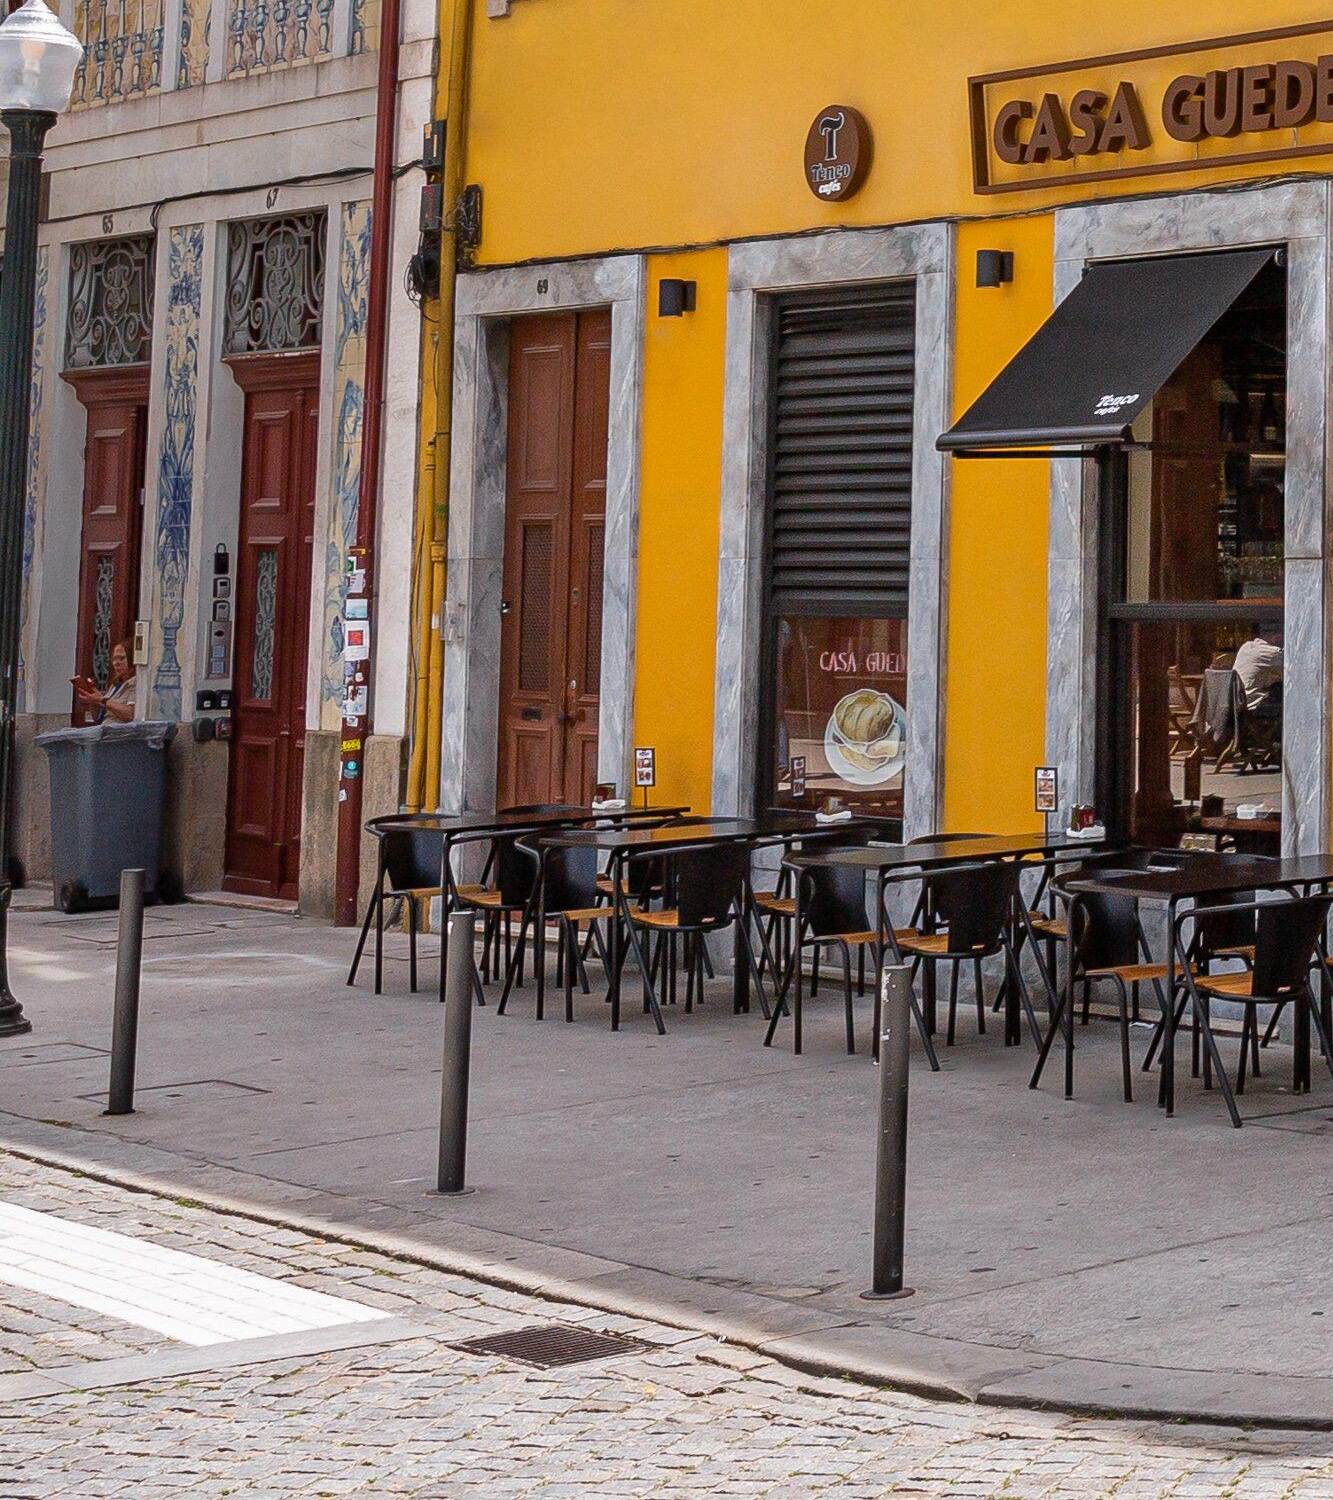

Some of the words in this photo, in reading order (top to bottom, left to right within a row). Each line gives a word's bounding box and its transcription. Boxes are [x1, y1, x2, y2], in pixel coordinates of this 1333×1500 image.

[993, 80, 1153, 164] CASA
[810, 162, 851, 183] Tenco
[265, 187, 280, 210] 67
[536, 278, 549, 295] 69
[1095, 393, 1140, 408] Tenco
[820, 651, 857, 673] CASA
